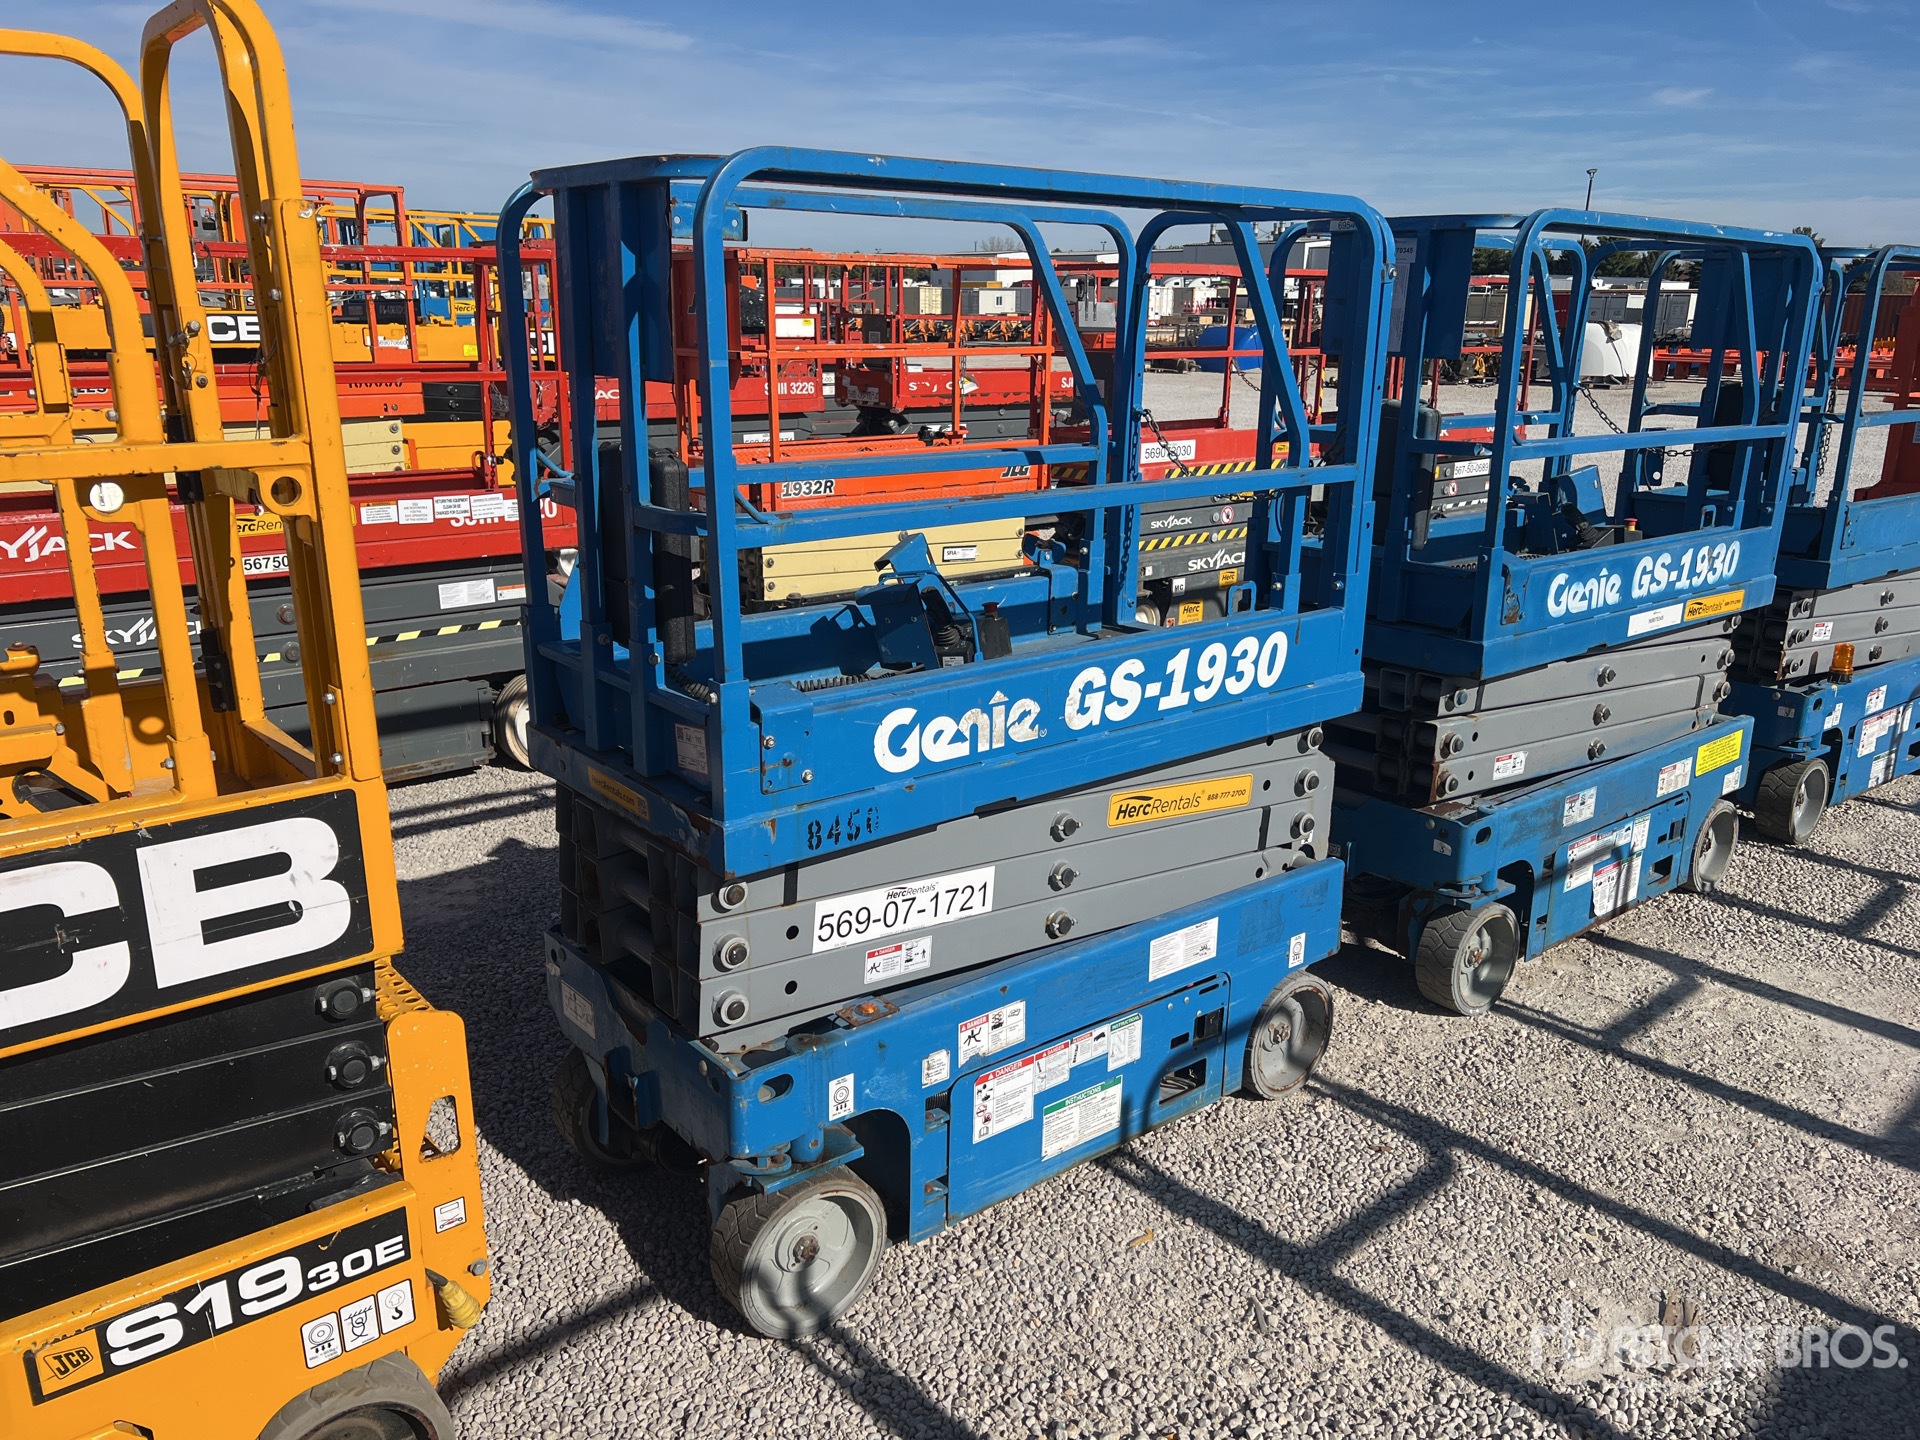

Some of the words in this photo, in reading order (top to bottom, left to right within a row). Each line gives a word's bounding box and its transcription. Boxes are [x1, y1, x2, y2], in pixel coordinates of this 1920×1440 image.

[790, 382, 815, 395] 3226
[782, 479, 835, 498] 1932R
[1150, 515, 1192, 529] SKYJACK
[1222, 573, 1235, 581] Herc
[1548, 568, 1621, 618] Genie
[1631, 540, 1741, 600] GS-1930
[1182, 604, 1200, 614] Herc
[874, 690, 1041, 773] Genie
[1064, 631, 1289, 731] GS-1930
[1116, 793, 1201, 820] HercRentals
[886, 883, 937, 900] HercRentals
[817, 881, 988, 942] 569-07-1721
[966, 1016, 987, 1028] DANGER
[1047, 1044, 1065, 1056] DANGER
[995, 1061, 1022, 1077] DANGER
[1065, 1085, 1102, 1106] INSTRUCTIONS
[105, 1234, 406, 1367] S1930E
[52, 1349, 90, 1376] JCB
